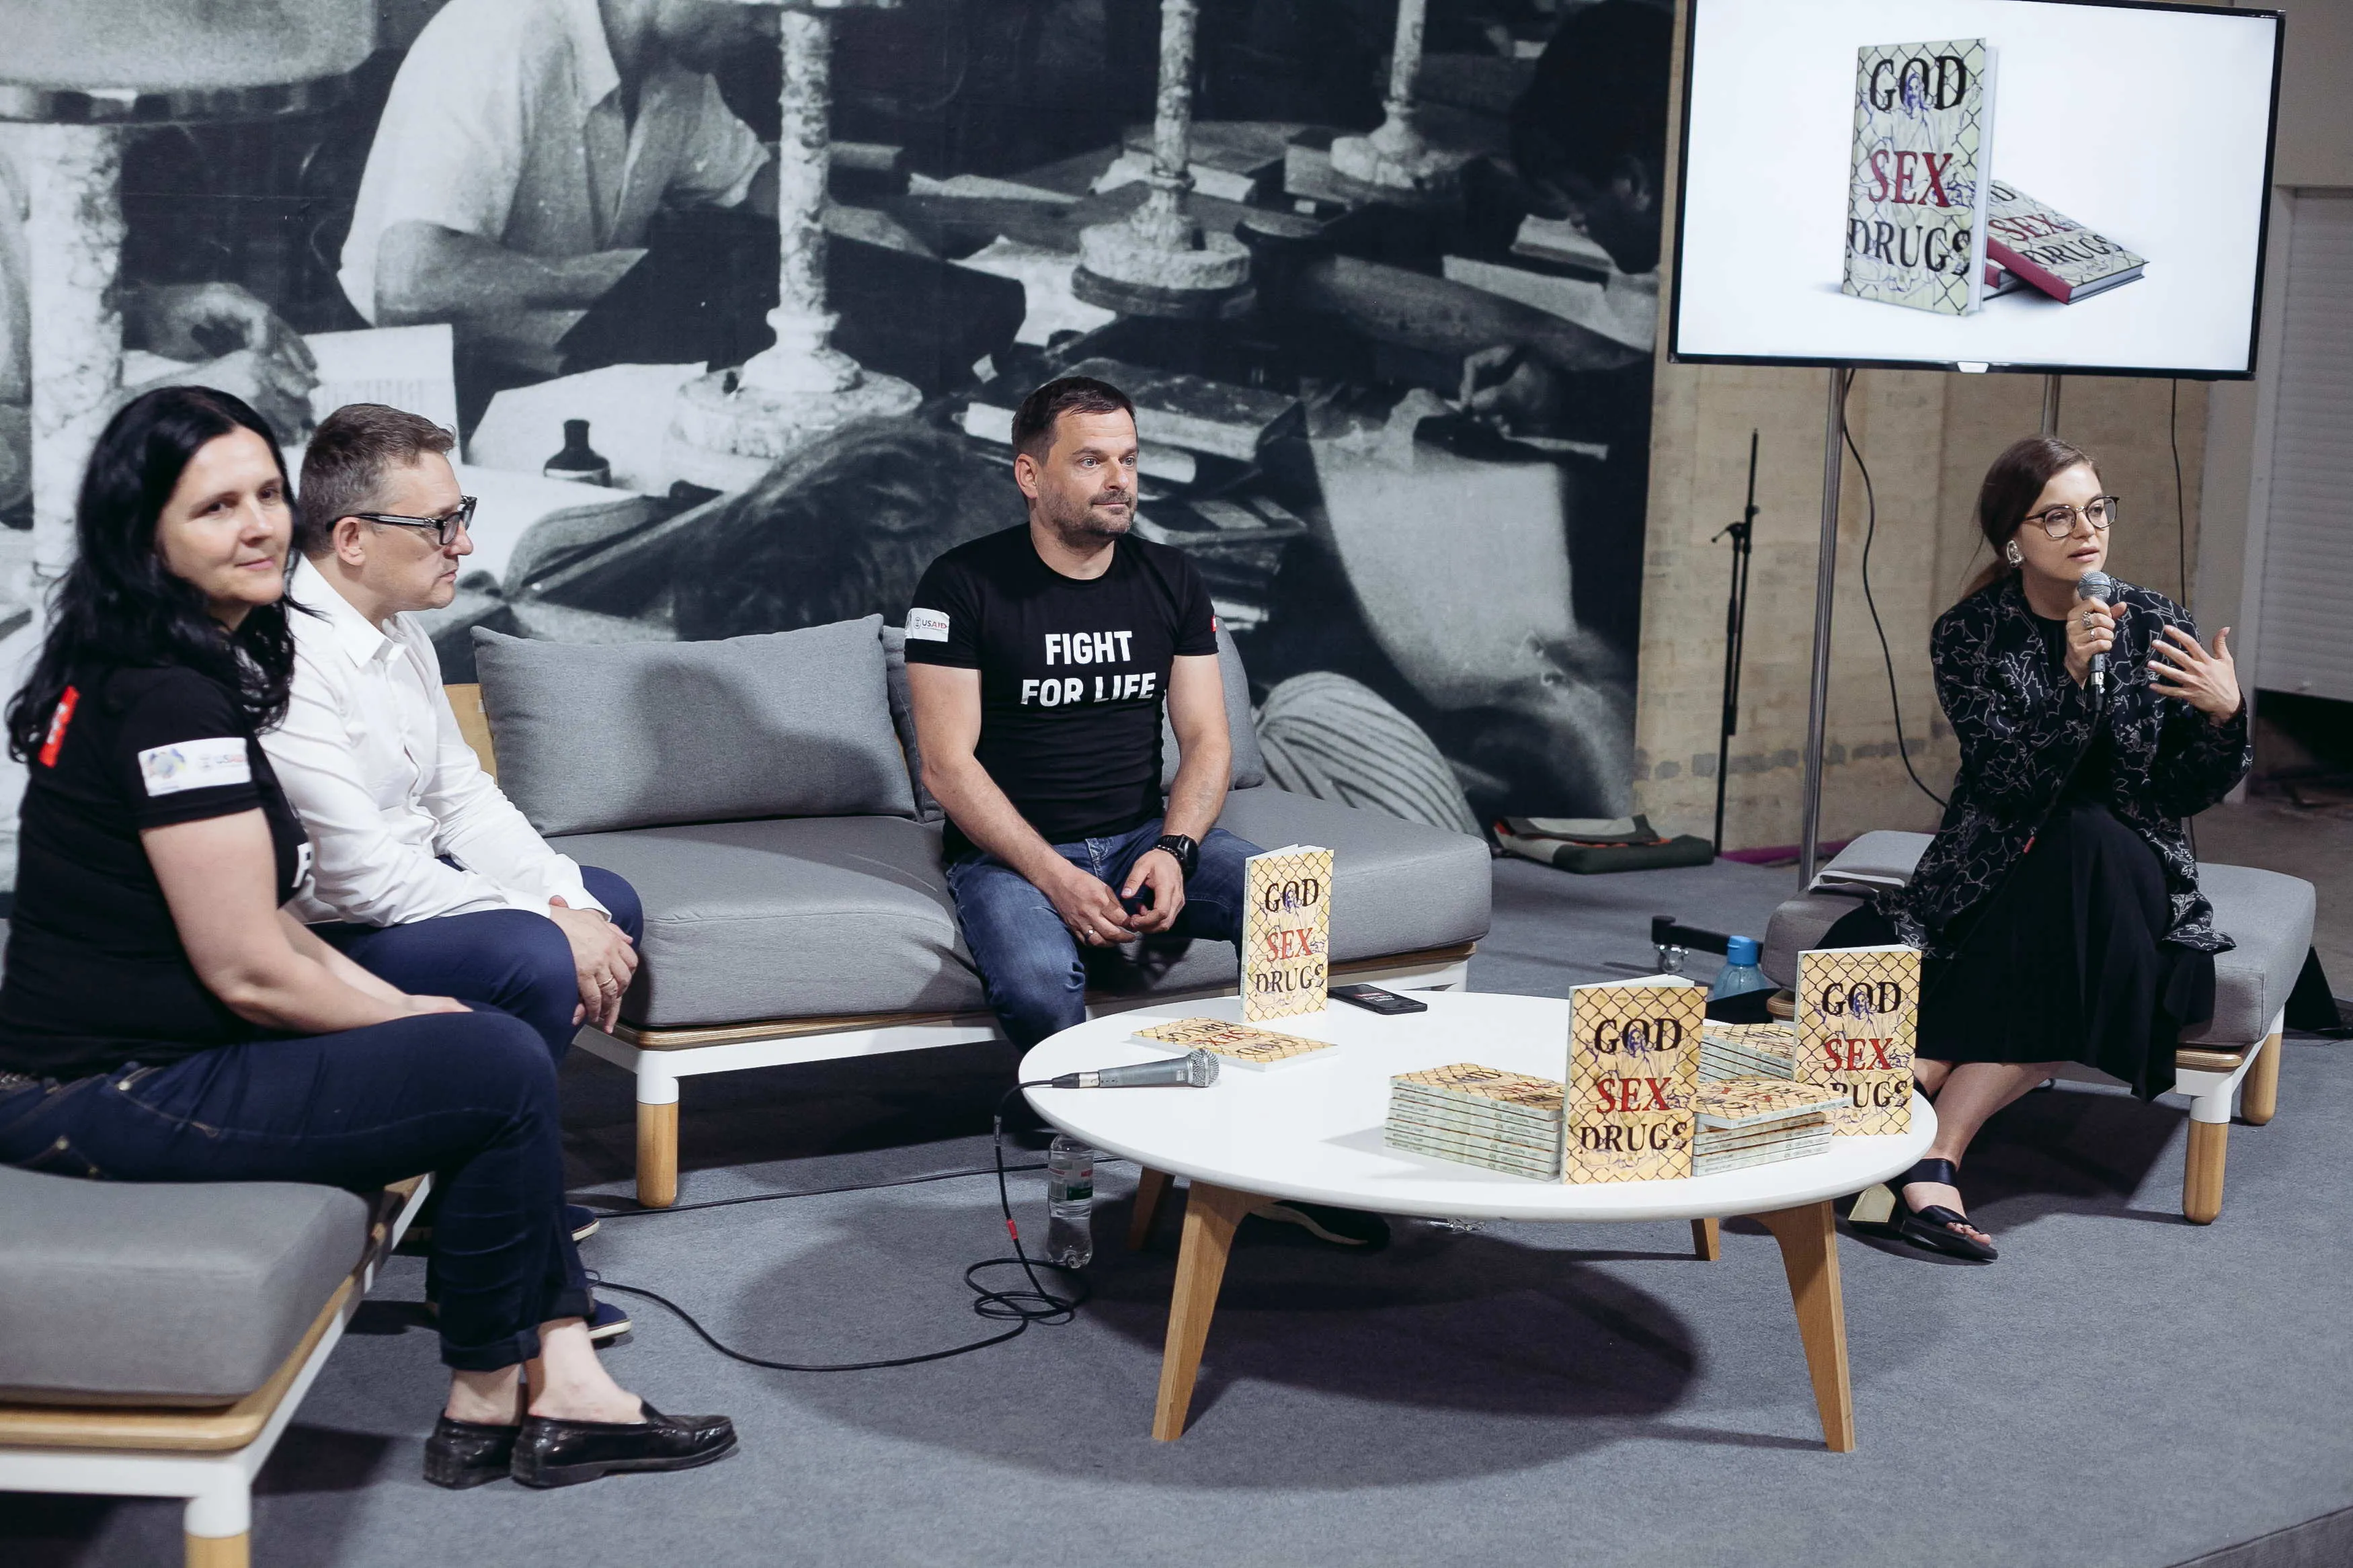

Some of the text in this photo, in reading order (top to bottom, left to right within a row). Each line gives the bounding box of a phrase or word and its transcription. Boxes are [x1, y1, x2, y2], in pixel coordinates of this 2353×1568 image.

[1869, 55, 1966, 111] GOD
[1868, 149, 1954, 208] SEX
[1988, 213, 2075, 241] SEX
[1847, 217, 1972, 276] DRUGS
[2021, 235, 2123, 265] DRUGS
[922, 619, 947, 629] USAID
[1045, 630, 1133, 665] FIGHT
[1021, 672, 1156, 707] FOR LIFE
[1265, 878, 1319, 913] GOD
[1267, 927, 1313, 962] SEX
[1254, 963, 1325, 997] DRUGS
[1822, 982, 1902, 1016] GOD
[1594, 1018, 1682, 1055] GOD
[1824, 1038, 1893, 1071] SEX
[1596, 1077, 1673, 1114] SEX
[1579, 1122, 1688, 1155] DRUGS
